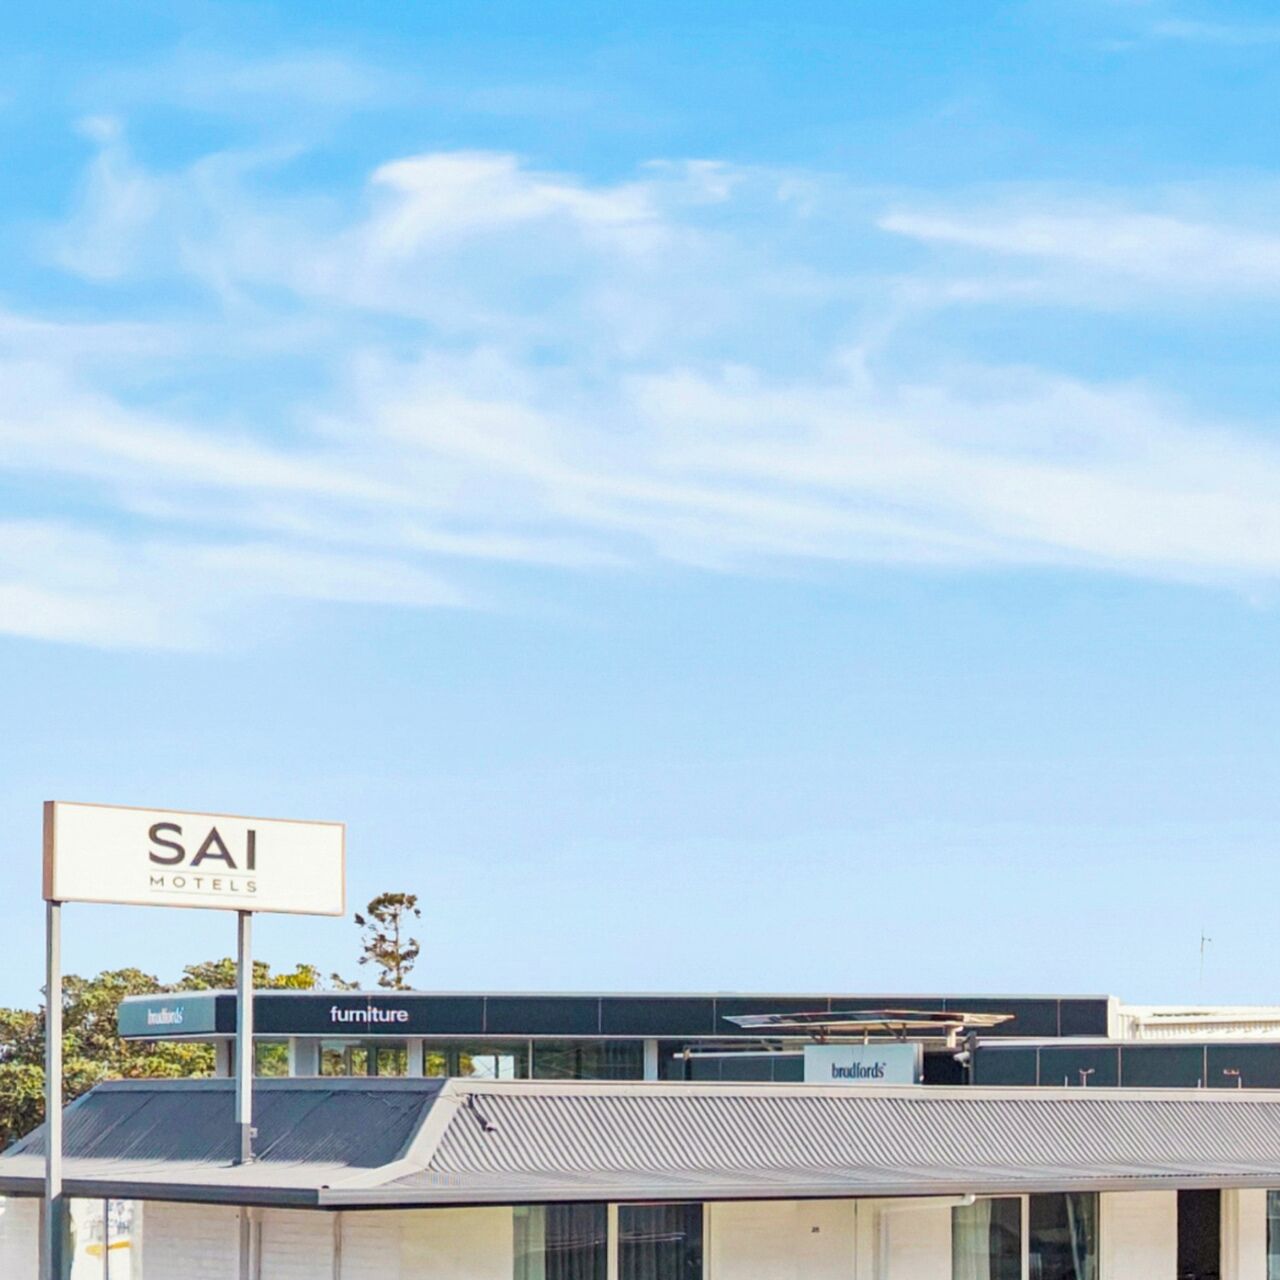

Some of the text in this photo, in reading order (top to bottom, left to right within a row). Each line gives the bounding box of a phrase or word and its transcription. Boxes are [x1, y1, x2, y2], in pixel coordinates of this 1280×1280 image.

[148, 822, 256, 871] SAI
[149, 875, 258, 893] MOTELS
[330, 1005, 409, 1023] furniture
